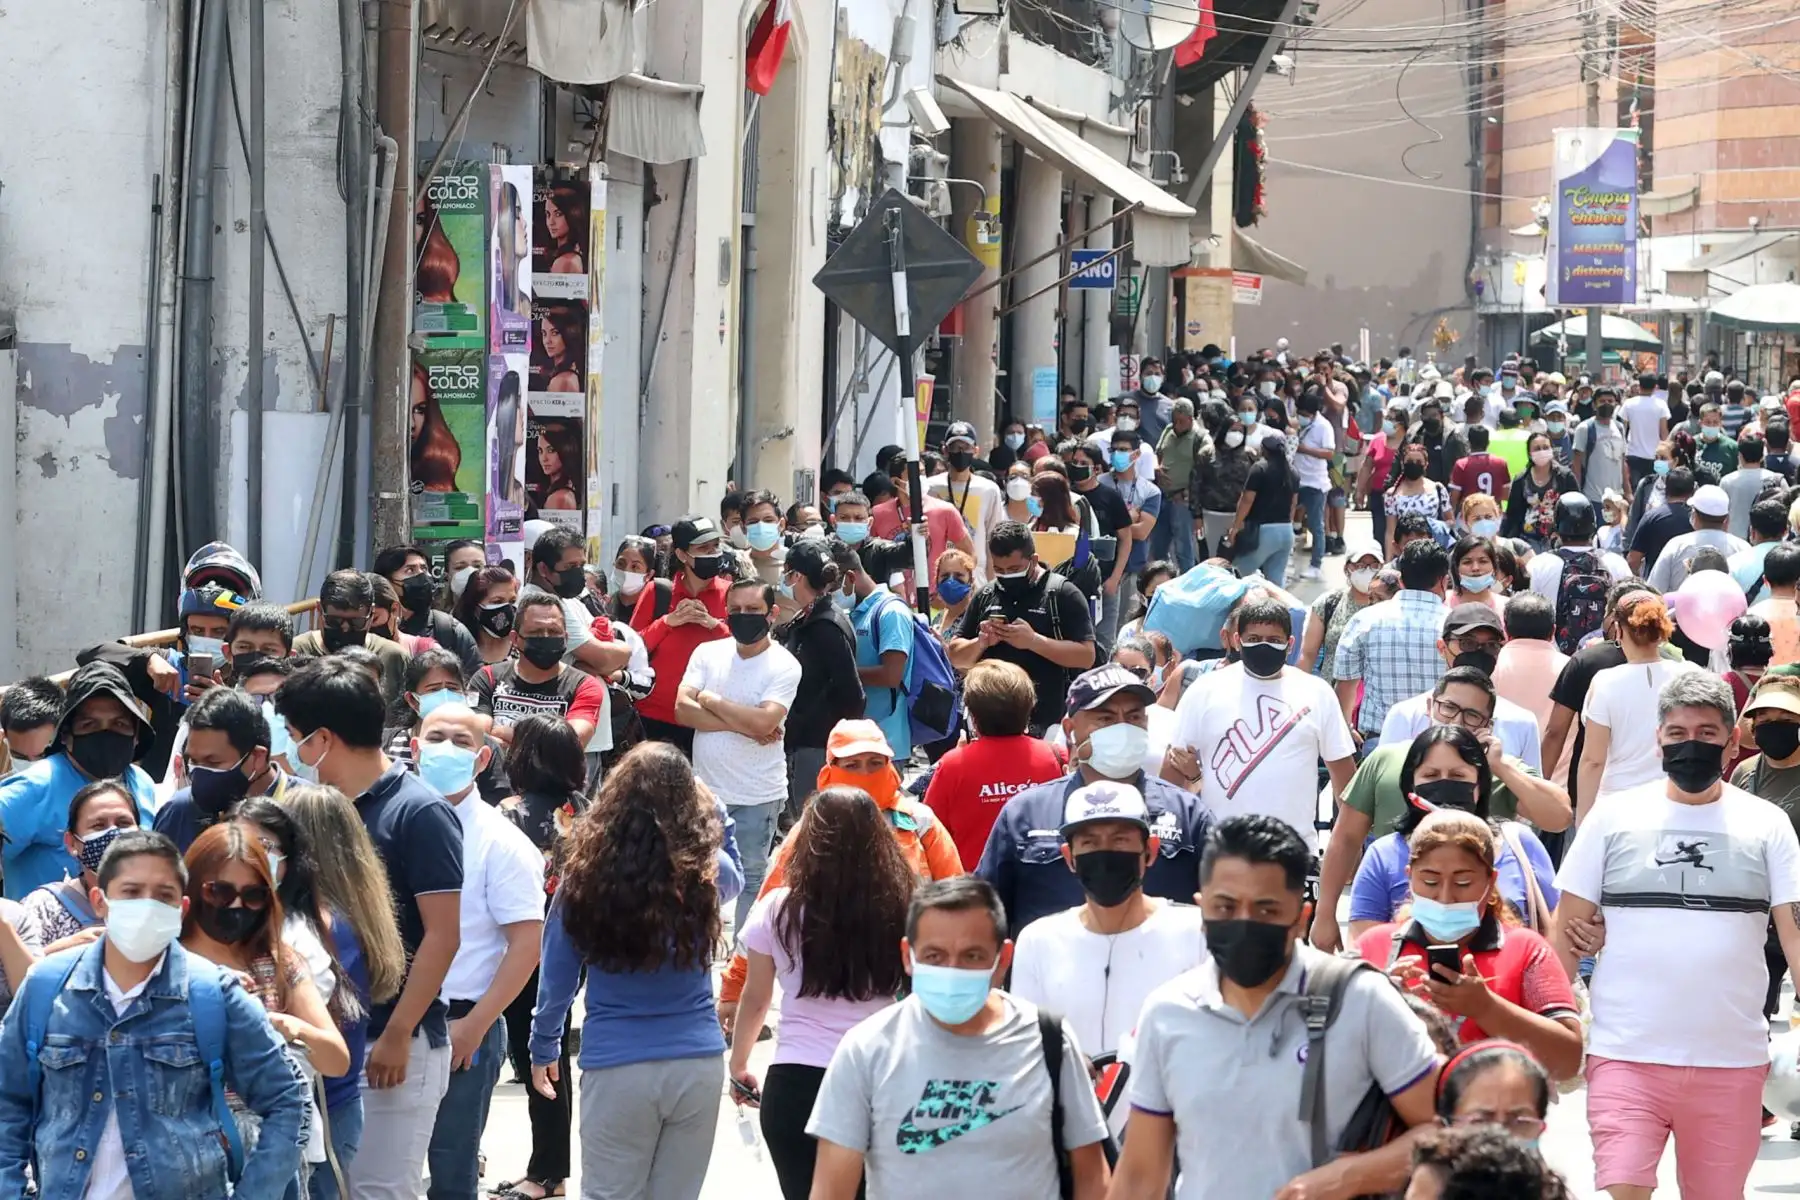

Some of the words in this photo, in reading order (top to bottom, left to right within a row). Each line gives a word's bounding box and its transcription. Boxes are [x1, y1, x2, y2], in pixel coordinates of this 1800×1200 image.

[430, 175, 479, 187] PRO
[427, 186, 479, 200] COLOR
[1564, 185, 1631, 207] Compra
[1070, 258, 1113, 279] BAÑO
[1572, 265, 1625, 277] distancia
[428, 365, 479, 376] PRO
[428, 376, 479, 389] COLOR
[1477, 472, 1493, 497] 9
[494, 701, 560, 715] BROOKLYN
[1211, 694, 1293, 790] FILA
[914, 1080, 1001, 1119] NIKE
